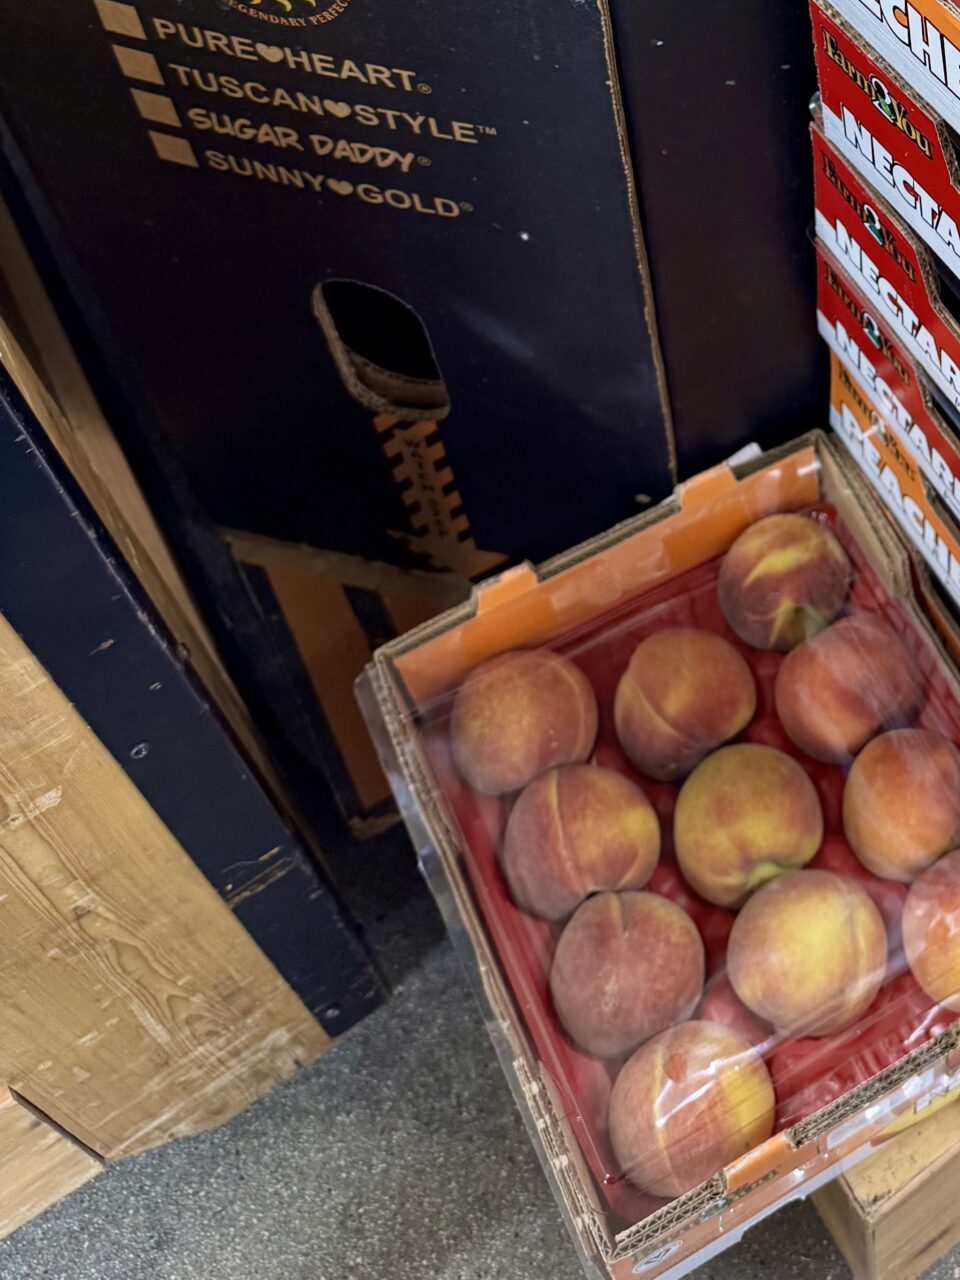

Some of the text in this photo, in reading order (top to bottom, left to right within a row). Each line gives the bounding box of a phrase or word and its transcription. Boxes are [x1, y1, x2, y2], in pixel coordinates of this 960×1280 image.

[152, 17, 259, 62] PURE
[168, 63, 325, 117] TUSCAN
[186, 107, 305, 152] SUGAR
[204, 148, 329, 193] SUNNY
